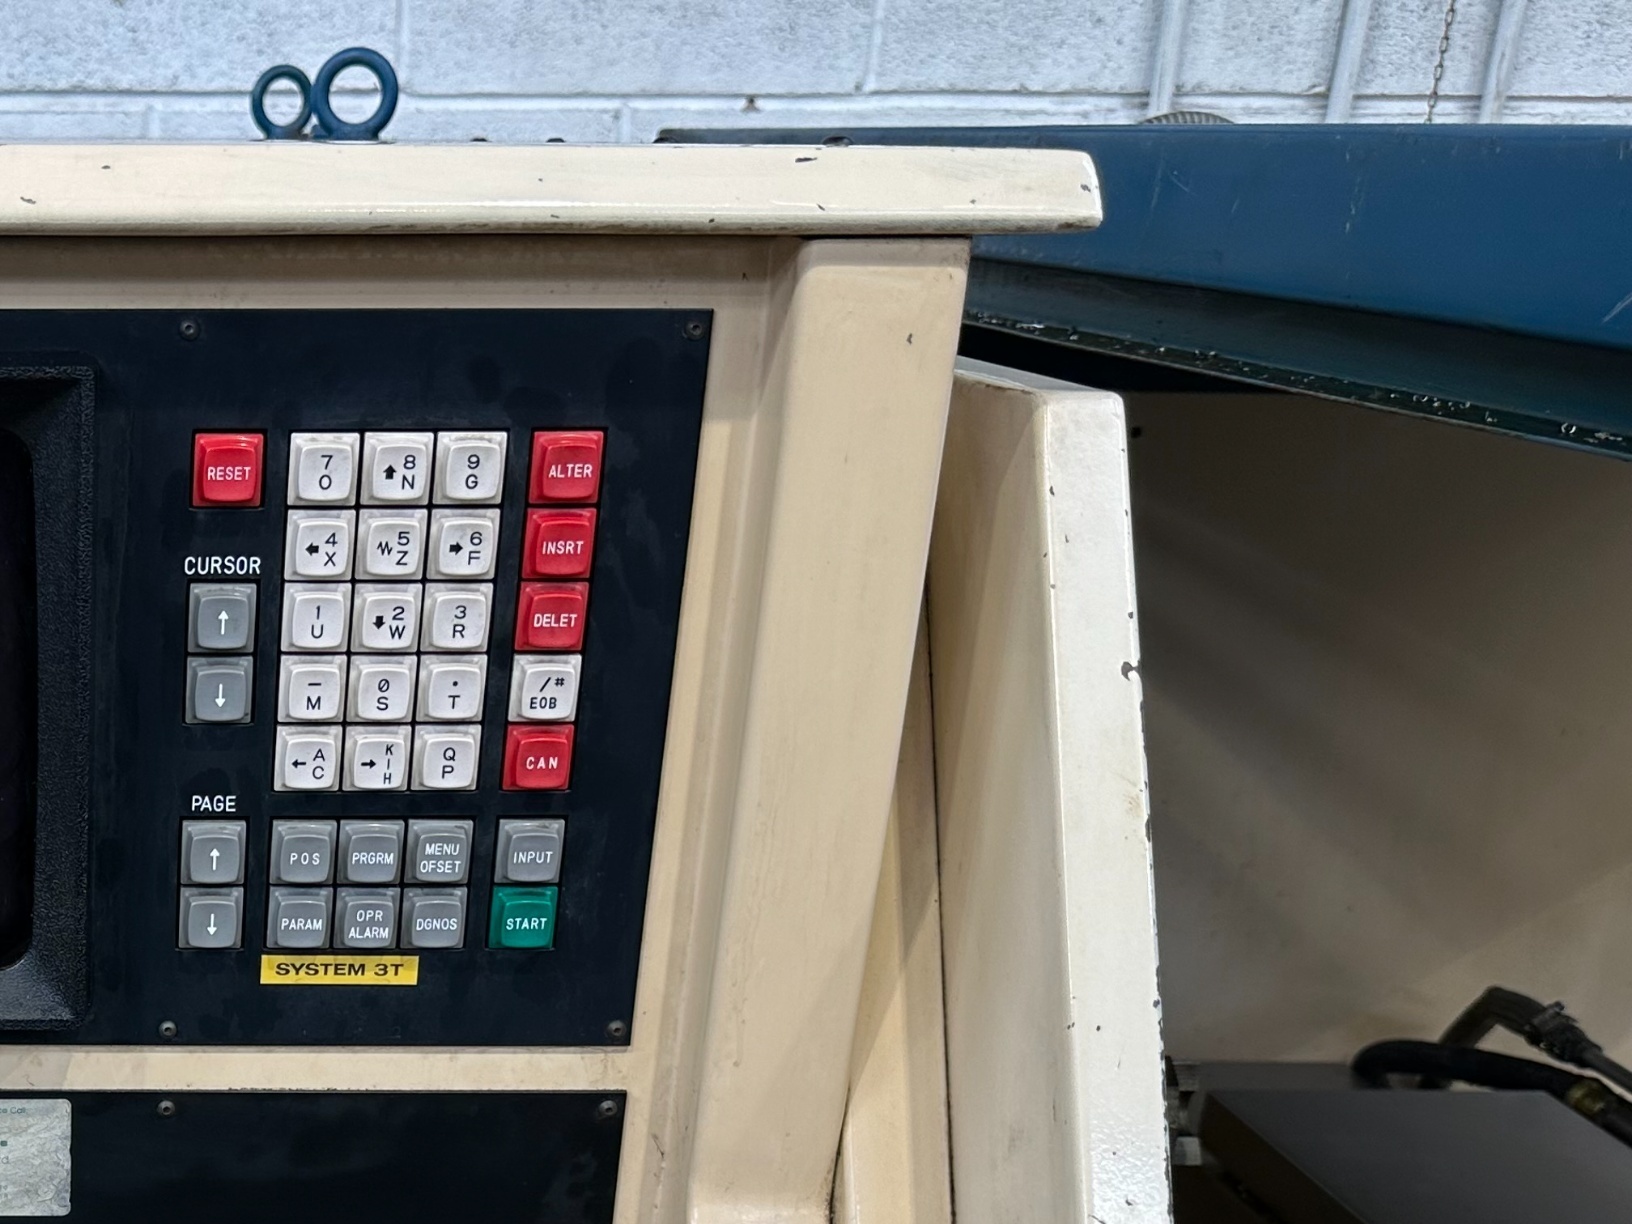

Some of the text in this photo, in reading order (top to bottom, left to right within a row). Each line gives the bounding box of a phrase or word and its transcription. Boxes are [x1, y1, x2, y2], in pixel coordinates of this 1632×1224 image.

[320, 455, 334, 470] 7
[403, 455, 416, 470] 8
[467, 454, 480, 470] 9
[207, 466, 251, 481] RESET
[548, 464, 593, 478] ALTER
[402, 474, 415, 490] N
[465, 474, 478, 489] G
[325, 532, 338, 547] 4
[397, 532, 410, 546] 5
[469, 532, 483, 546] 6
[542, 541, 583, 555] INSRT
[184, 556, 261, 575] CURSOR
[323, 552, 337, 567] X
[396, 551, 409, 566] Z
[468, 551, 481, 566] F
[314, 605, 320, 620] 1
[392, 605, 405, 621] 2
[455, 605, 467, 620] 3
[534, 614, 577, 628] DELET
[310, 624, 323, 639] U
[389, 624, 406, 639] W
[452, 624, 465, 639] R
[306, 696, 321, 711] M
[376, 696, 389, 711] S
[448, 696, 460, 710] T
[529, 697, 557, 710] EOB
[312, 749, 326, 762] A
[385, 744, 394, 756] K
[443, 747, 456, 762] Q
[525, 757, 558, 770] CAN
[311, 766, 325, 780] C
[383, 773, 392, 785] H
[441, 765, 455, 780] P
[191, 796, 236, 812] PAGE
[425, 843, 460, 857] MENU
[513, 851, 553, 864] INPUT
[290, 852, 320, 866] POS
[352, 852, 394, 866] PRGRM
[420, 860, 461, 874] OFSET
[356, 909, 383, 923] OPR
[281, 918, 322, 931] PARAM
[416, 918, 457, 931] DGNOS
[506, 917, 547, 931] START
[348, 927, 389, 940] ALARM
[275, 962, 404, 977] SYSTEM 3T
